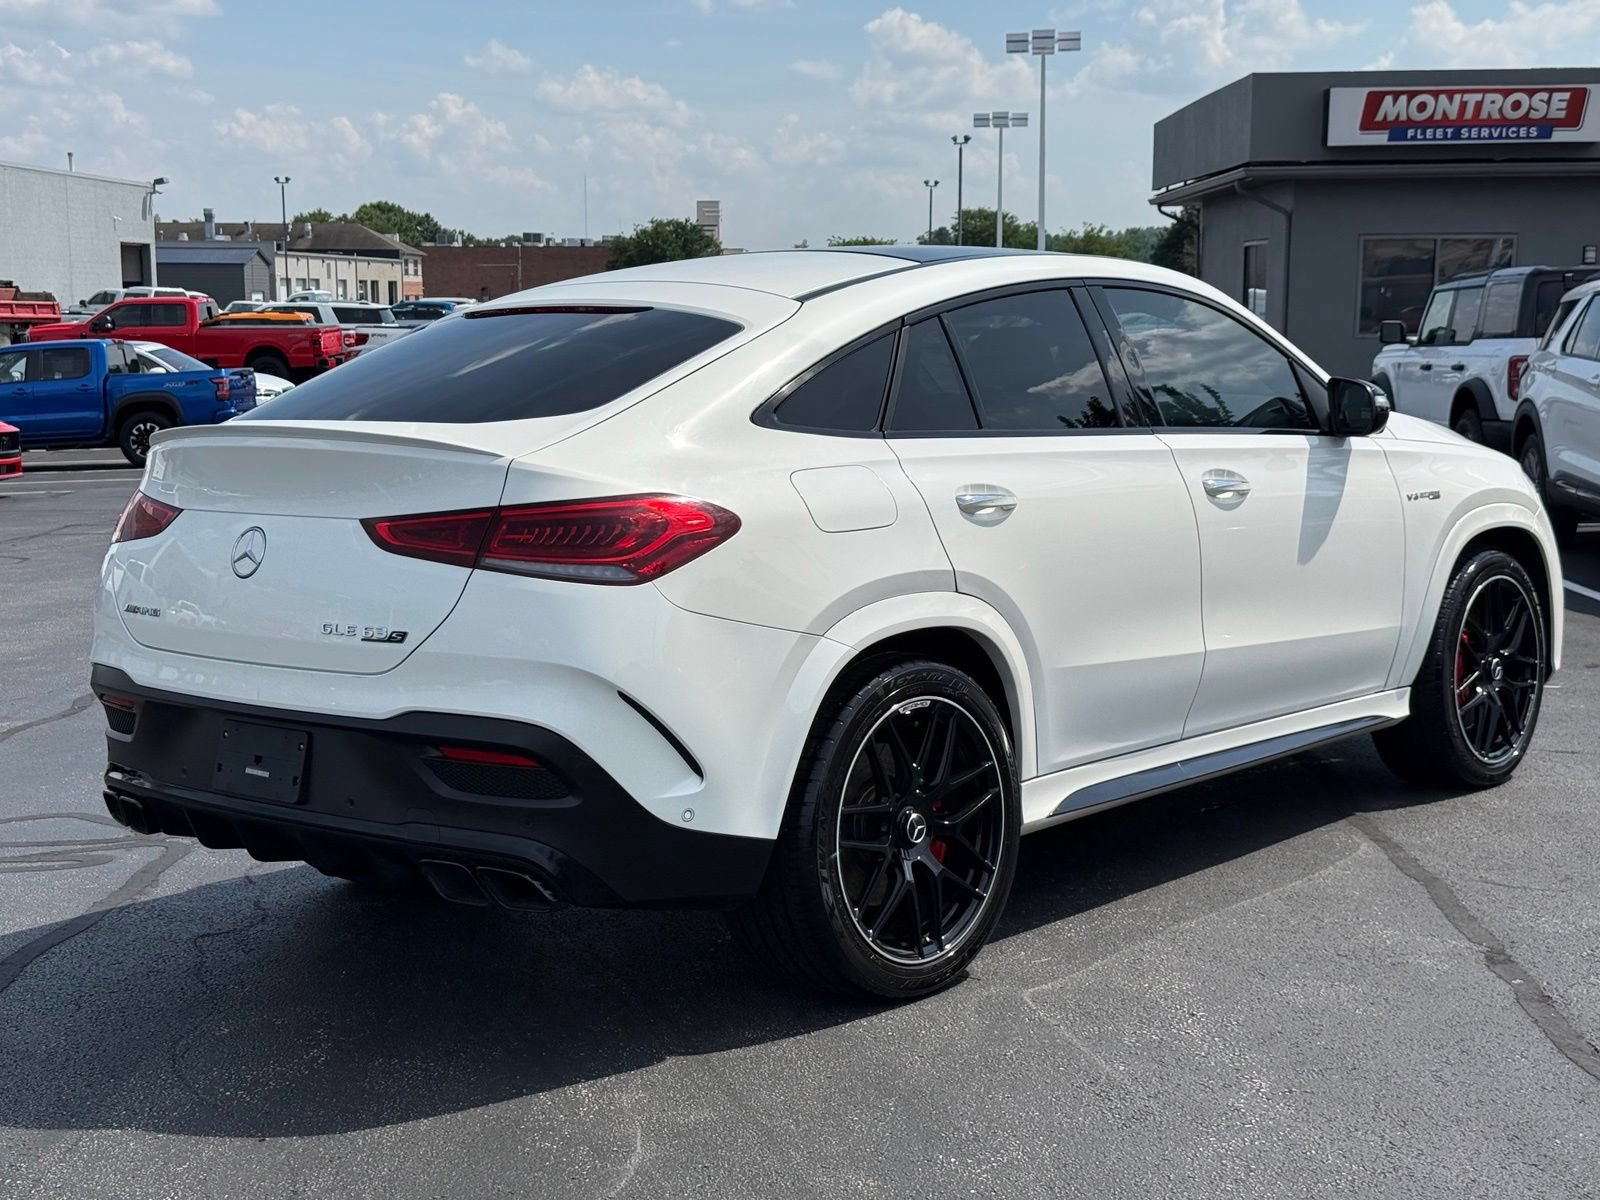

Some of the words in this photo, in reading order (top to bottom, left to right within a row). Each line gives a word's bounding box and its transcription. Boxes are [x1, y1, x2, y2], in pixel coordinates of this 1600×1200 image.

[1374, 92, 1572, 122] MONTROSE
[1407, 128, 1455, 140] FLEET
[1460, 126, 1538, 139] SERVICES
[321, 623, 358, 637] GLE
